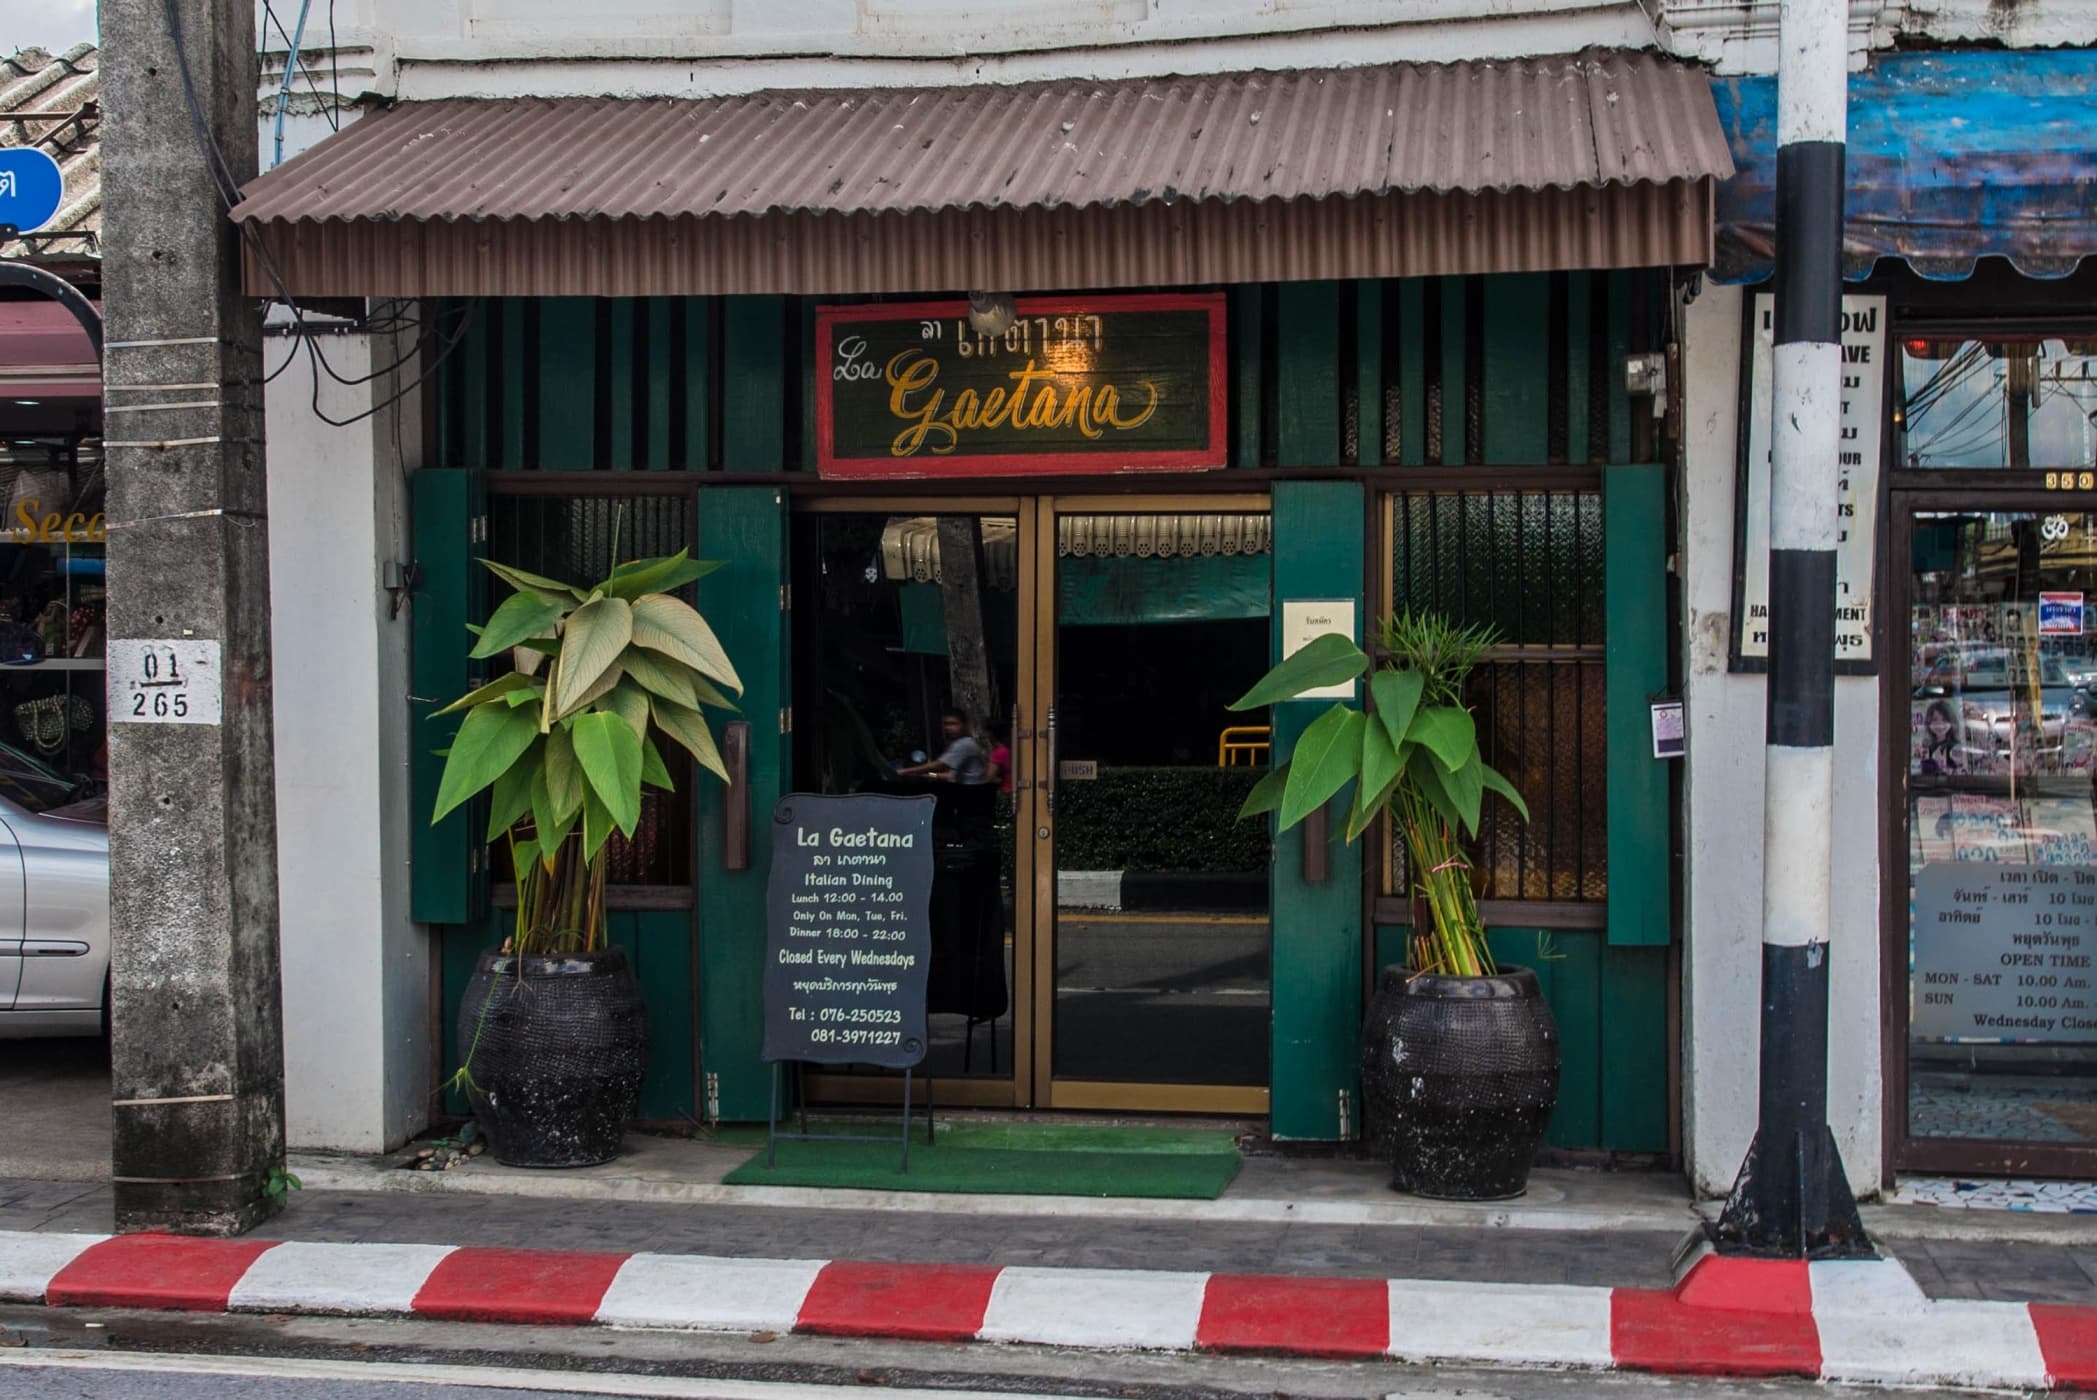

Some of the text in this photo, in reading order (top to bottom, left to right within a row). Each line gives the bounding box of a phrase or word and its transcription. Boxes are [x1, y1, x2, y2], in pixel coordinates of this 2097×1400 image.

[921, 320, 942, 341] ลา
[833, 336, 1158, 457] La Gaetana
[144, 653, 180, 678] 01
[133, 692, 189, 718] 265
[797, 827, 914, 848] La Gaetana
[805, 873, 894, 889] Italian Dining
[791, 893, 819, 903] Lunch
[823, 892, 857, 903] 12:00
[2048, 893, 2066, 905] 10
[793, 910, 815, 922] Only
[819, 910, 832, 921] On
[890, 911, 908, 921] Fri.
[2035, 913, 2053, 925] 10
[789, 926, 822, 938] Dinner
[826, 927, 859, 939] 18:00
[872, 929, 906, 941] 22:00
[778, 949, 915, 970] Closed Every Wednesdays
[2000, 953, 2091, 968] OPEN TIME
[793, 977, 898, 995] หยุดบริการทุกวันพุธ
[1925, 972, 1959, 984] MON
[1973, 973, 2002, 986] SAT
[2017, 975, 2058, 988] 10.00
[1924, 993, 1954, 1005] SUN
[2016, 995, 2058, 1008] 10.00
[789, 1007, 805, 1021] Tel
[819, 1008, 902, 1024] 076-250523
[1973, 1013, 2055, 1032] Wednesday
[811, 1029, 901, 1045] 081-3971227
